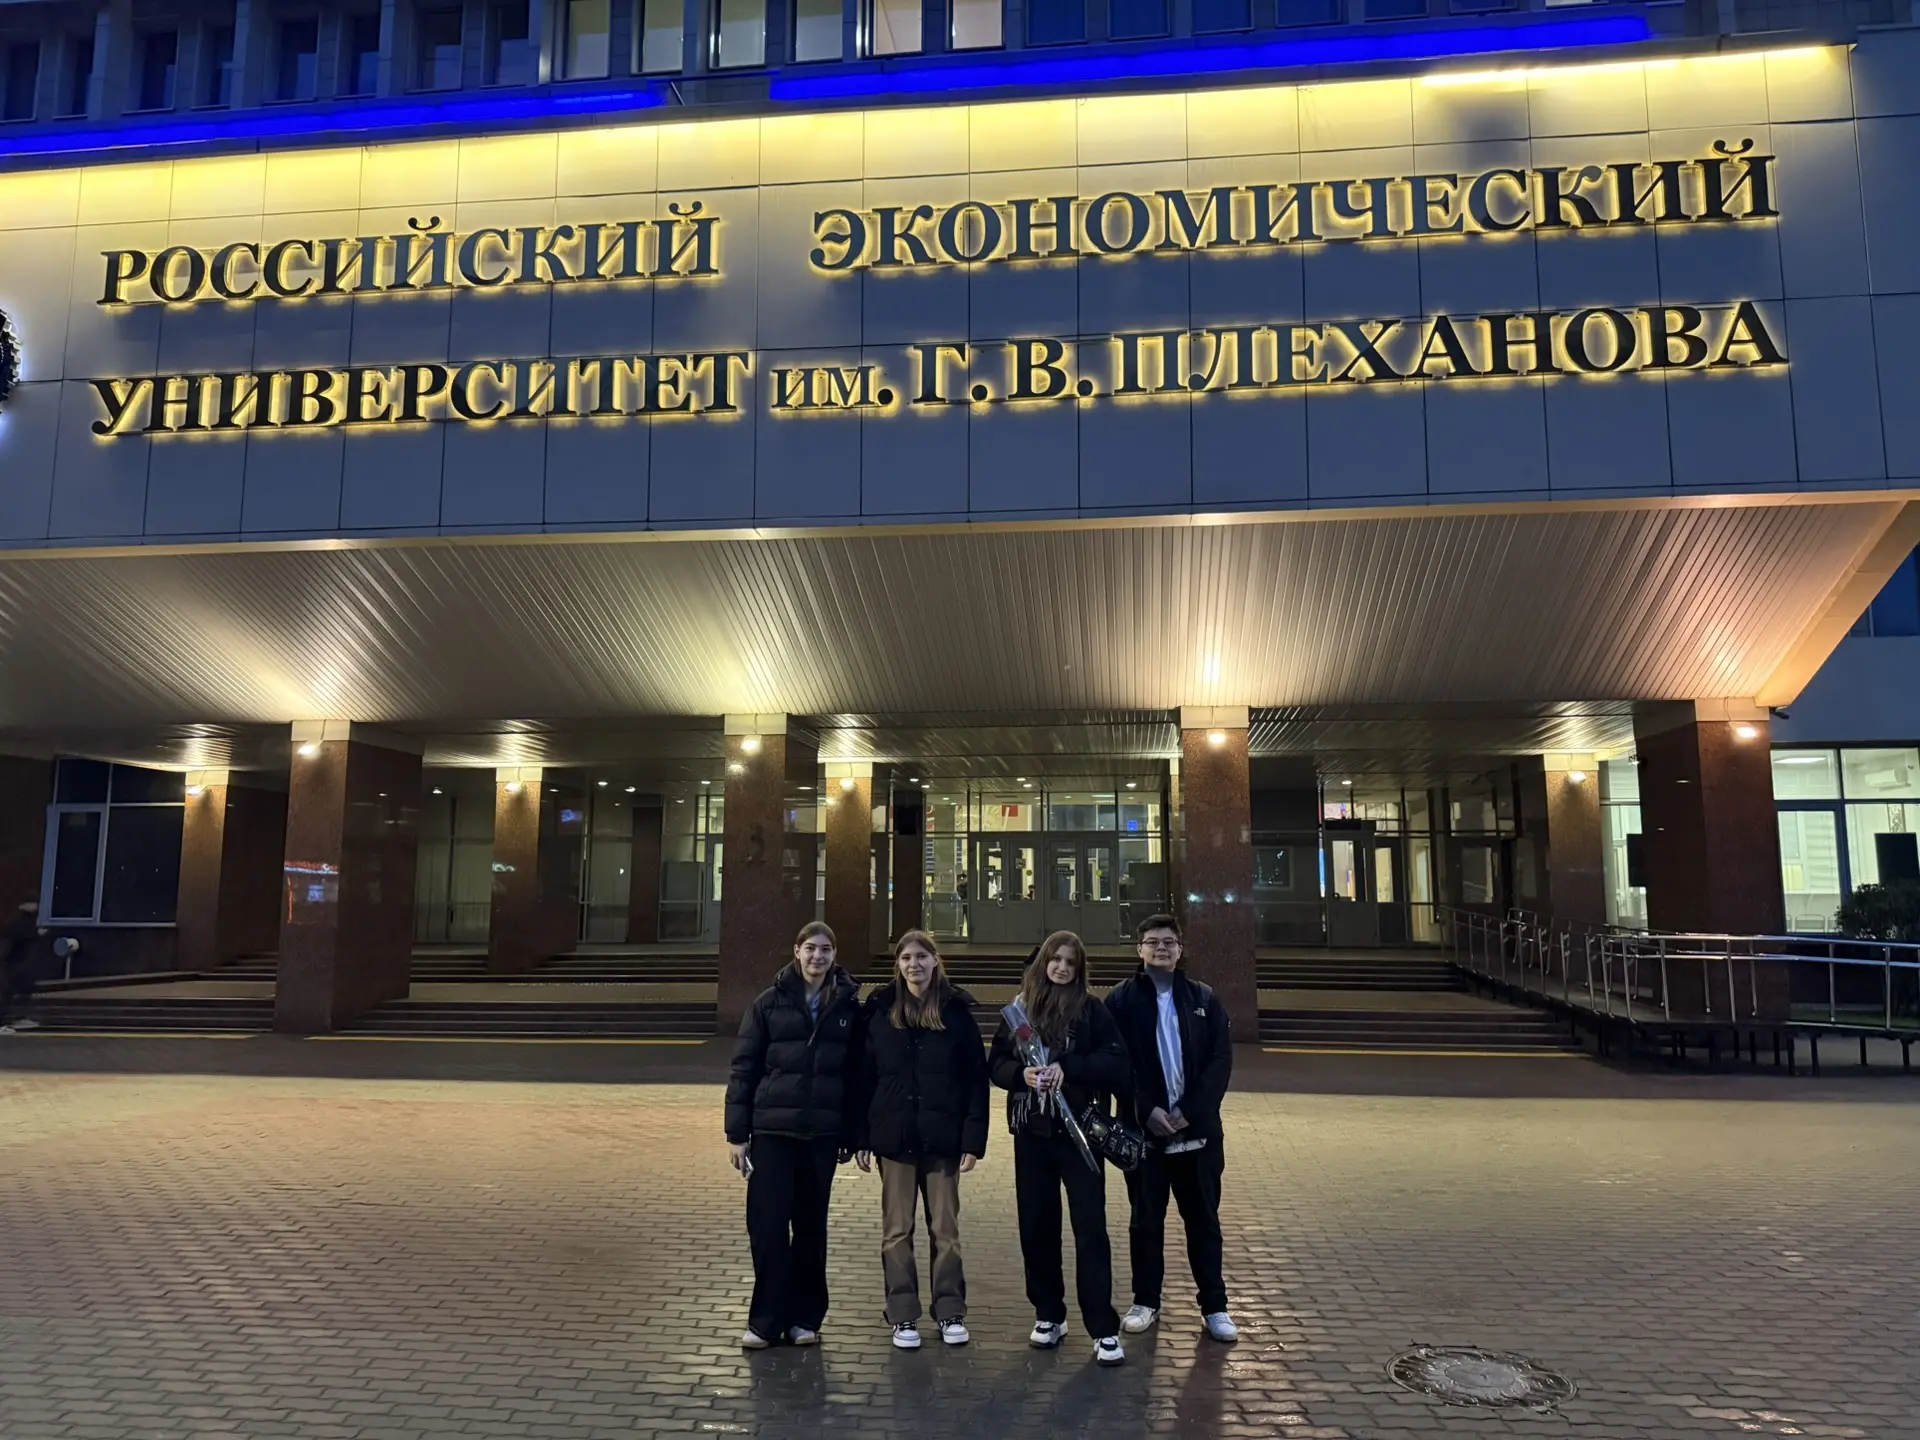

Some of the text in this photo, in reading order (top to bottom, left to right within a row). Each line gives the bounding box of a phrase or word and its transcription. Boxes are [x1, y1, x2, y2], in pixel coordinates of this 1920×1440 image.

[97, 138, 1779, 303] РОССИЙСКИЙ ЭКОНОМИЧЕСКИЙ
[89, 352, 751, 437] УНИВЕРСИТЕТ
[1111, 301, 1789, 392] ПЛЕХАНОВА
